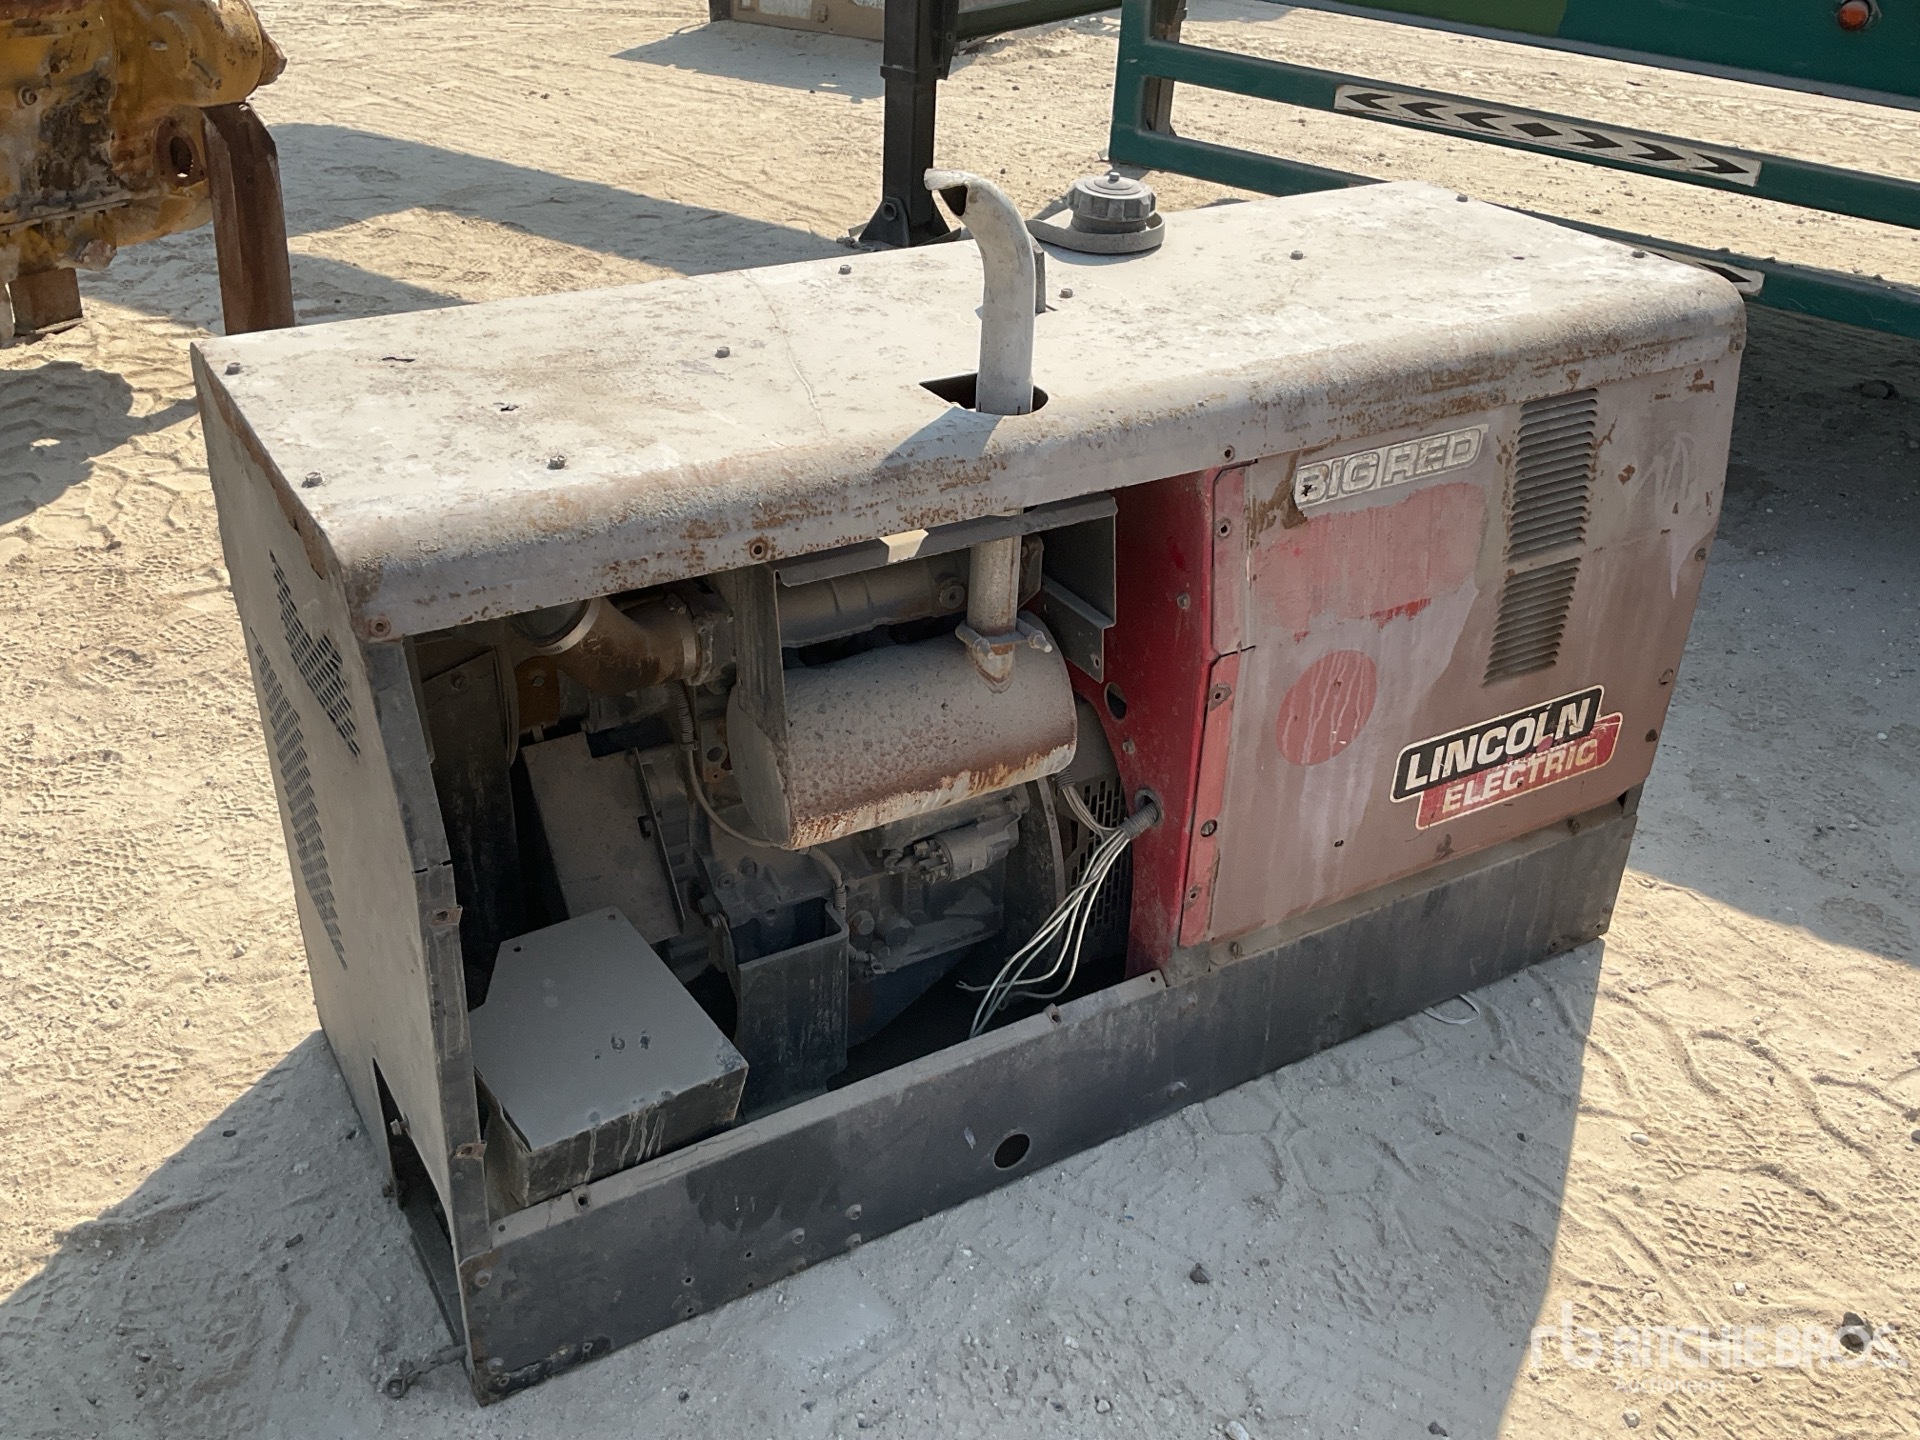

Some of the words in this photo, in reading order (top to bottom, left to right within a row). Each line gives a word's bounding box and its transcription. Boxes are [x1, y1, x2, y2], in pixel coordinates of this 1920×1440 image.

[1296, 452, 1379, 505] BIG
[1381, 428, 1481, 486] RED
[1405, 697, 1591, 790] LINCOLN
[1442, 738, 1598, 813] ELECTRIC
